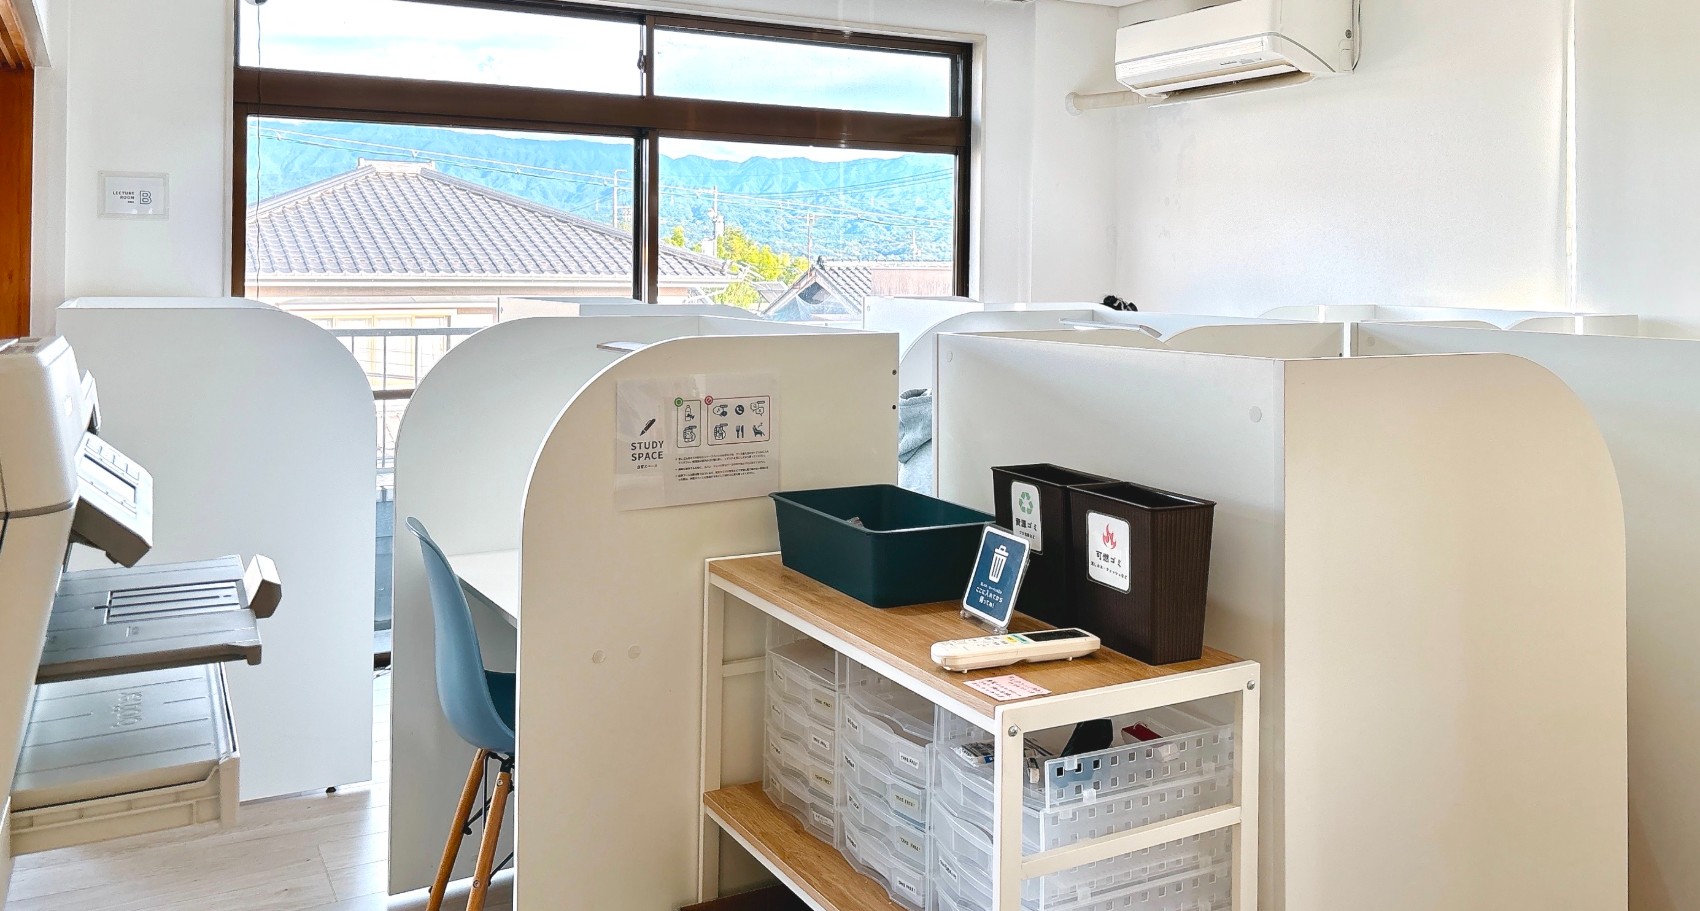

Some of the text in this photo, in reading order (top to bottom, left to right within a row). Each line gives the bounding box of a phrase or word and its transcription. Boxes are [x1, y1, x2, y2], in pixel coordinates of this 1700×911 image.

[139, 190, 152, 205] B
[630, 440, 664, 451] STUDY
[631, 450, 664, 462] SPACE
[1095, 550, 1122, 568] 可燃ゴミ
